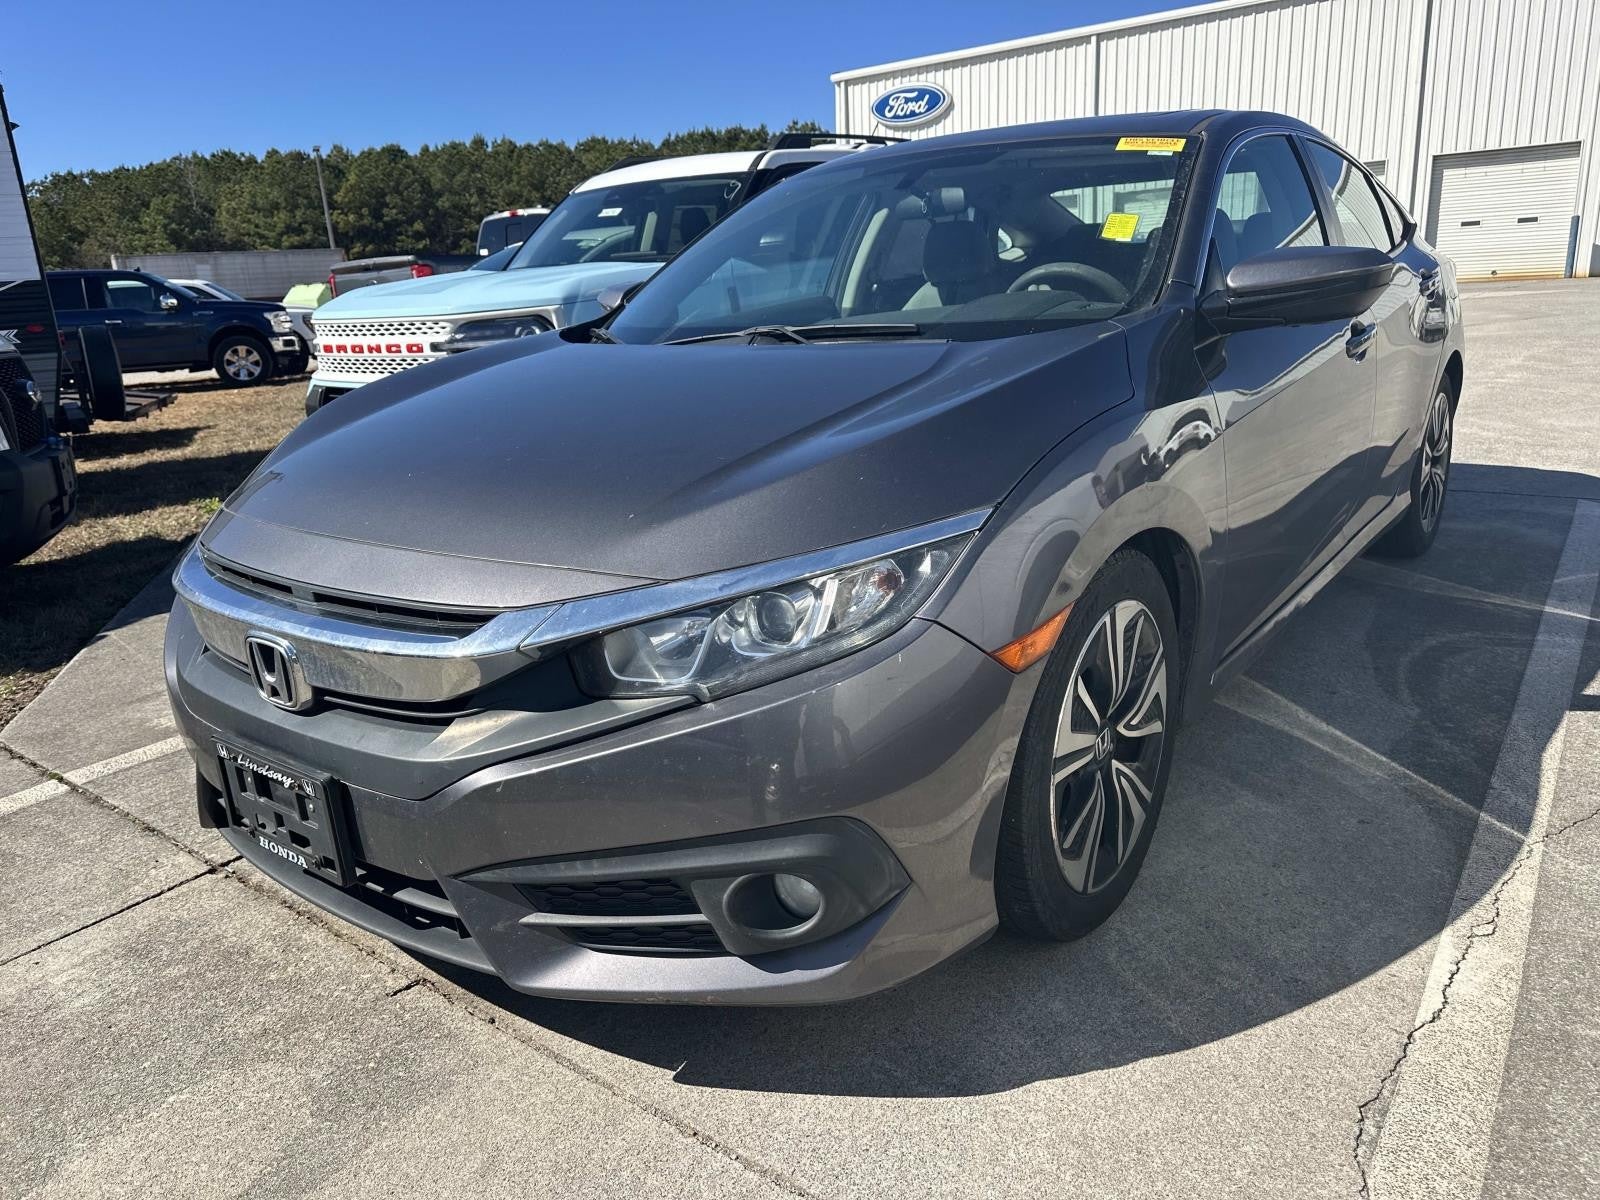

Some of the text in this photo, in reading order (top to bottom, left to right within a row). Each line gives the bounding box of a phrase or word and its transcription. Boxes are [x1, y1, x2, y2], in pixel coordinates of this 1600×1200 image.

[885, 91, 929, 118] Ford
[322, 343, 424, 354] BRONCO
[237, 754, 295, 788] Lindsay
[258, 836, 309, 869] HONDA
